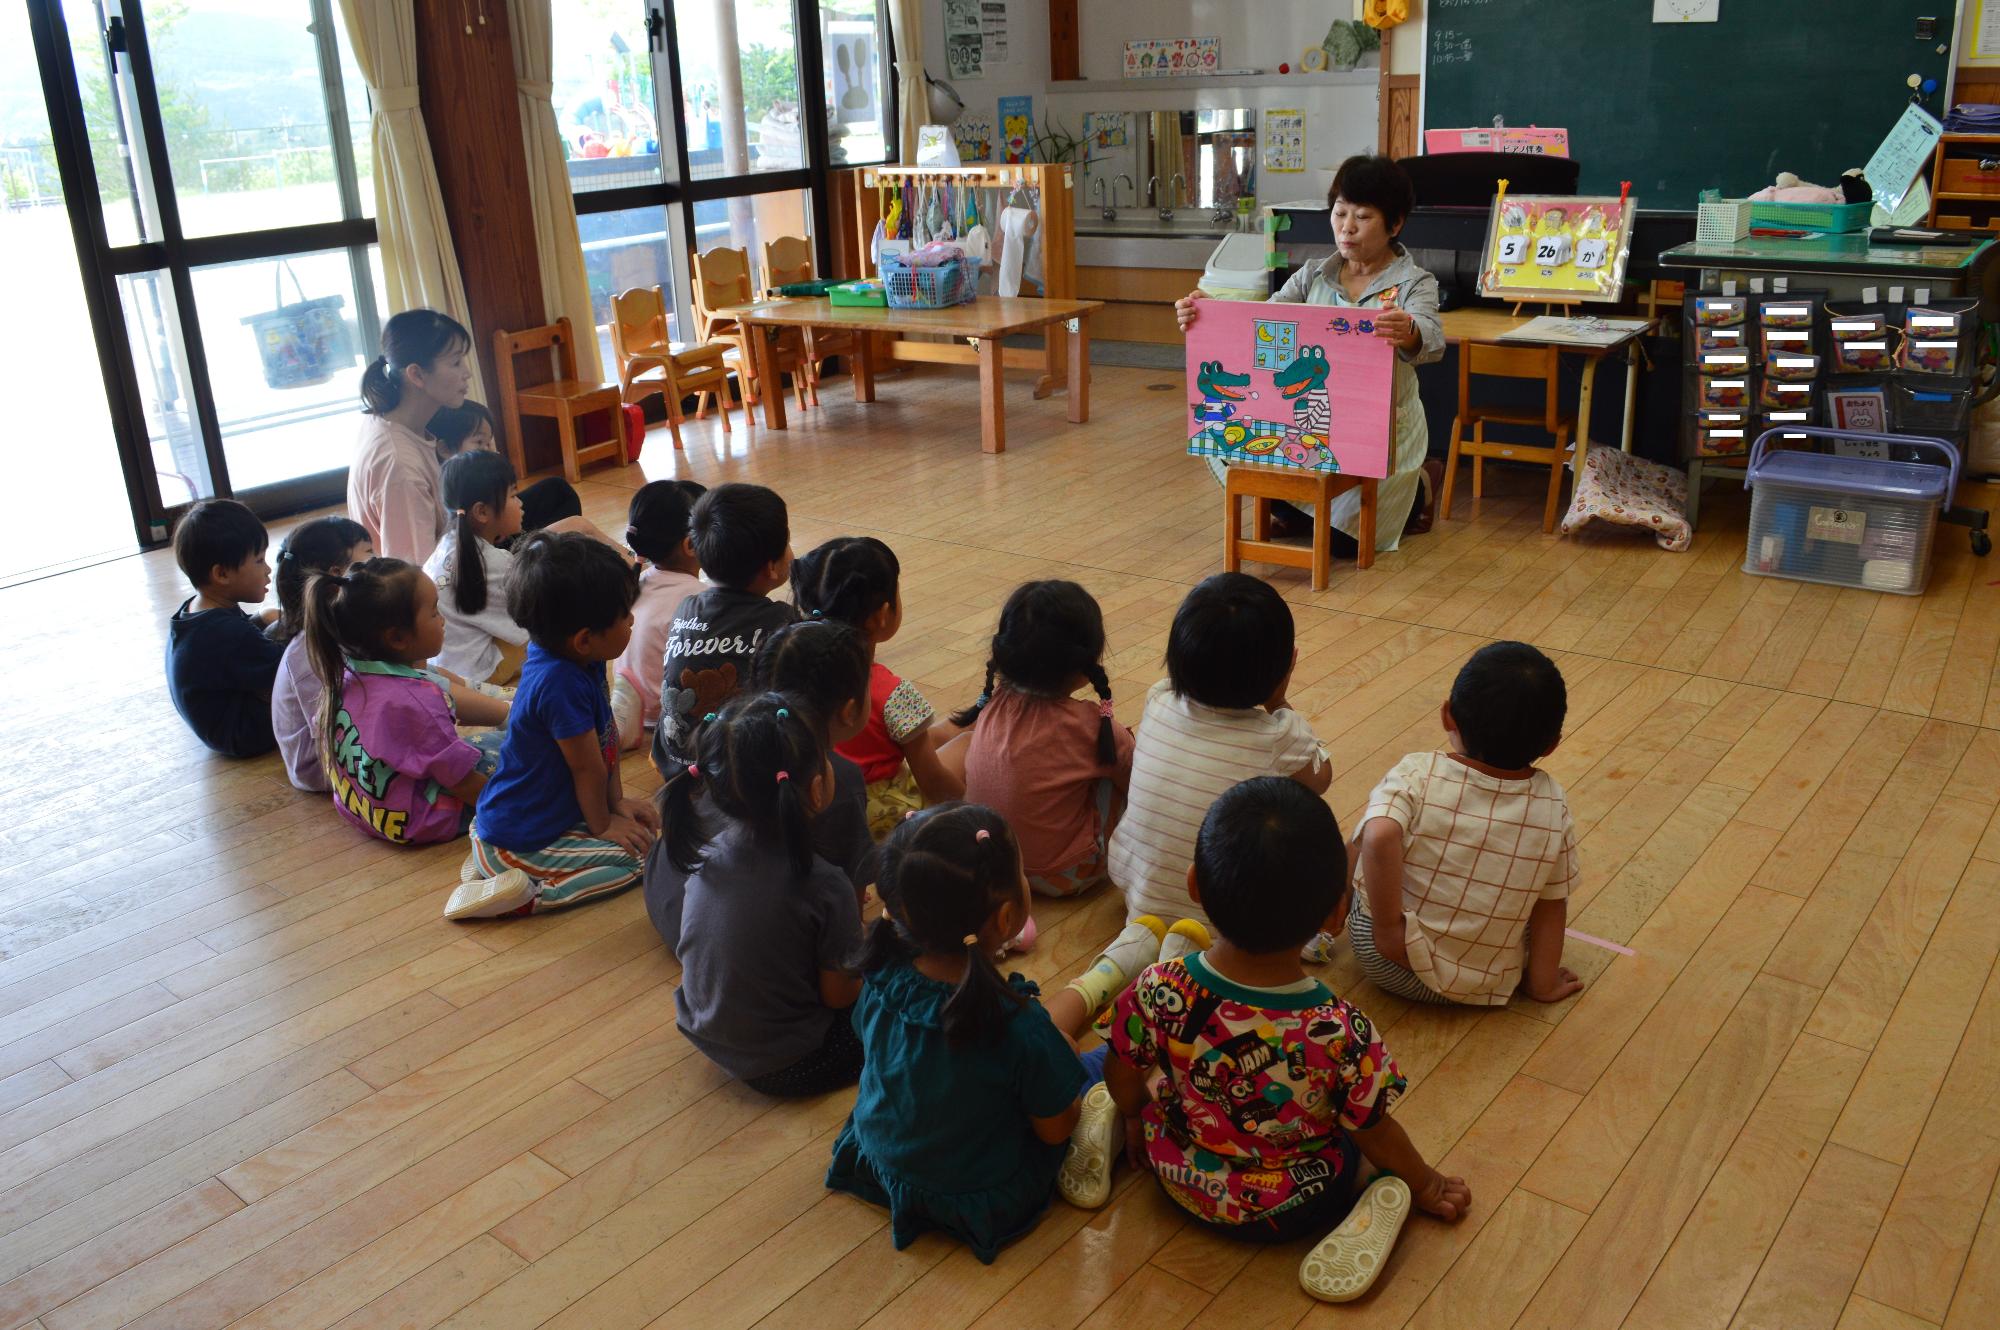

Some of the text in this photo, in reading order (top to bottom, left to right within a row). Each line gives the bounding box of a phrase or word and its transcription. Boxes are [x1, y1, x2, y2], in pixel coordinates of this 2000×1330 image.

[1504, 243, 1515, 256] 5
[1538, 246, 1556, 258] 26
[1582, 251, 1595, 263] か
[670, 616, 709, 634] Together
[663, 628, 763, 666] Forever!
[1238, 1044, 1271, 1075] JAM
